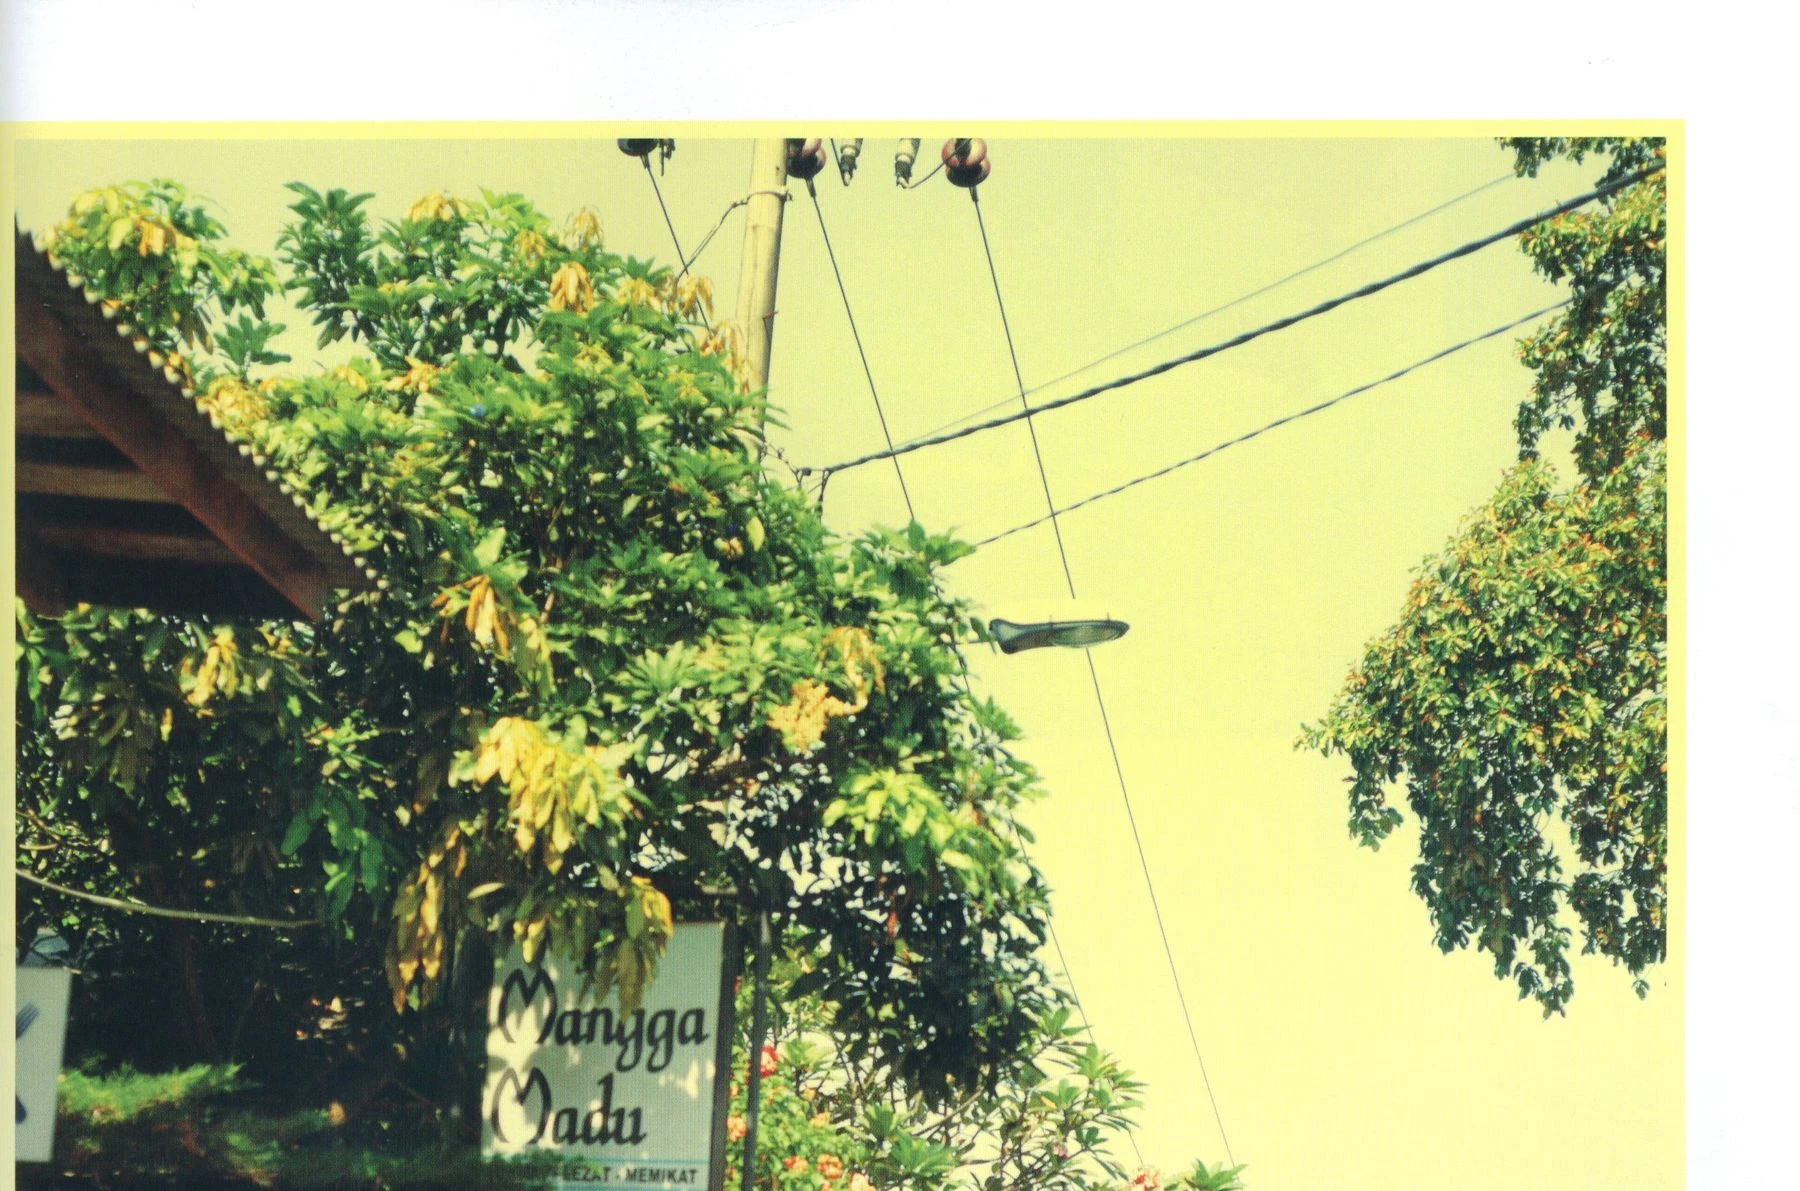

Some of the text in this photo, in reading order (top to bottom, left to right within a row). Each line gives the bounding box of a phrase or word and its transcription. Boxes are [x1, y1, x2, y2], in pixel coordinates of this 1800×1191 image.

[499, 968, 709, 1073] Mangga
[491, 1066, 648, 1147] Madu
[625, 1167, 698, 1184] MEMIKAT
